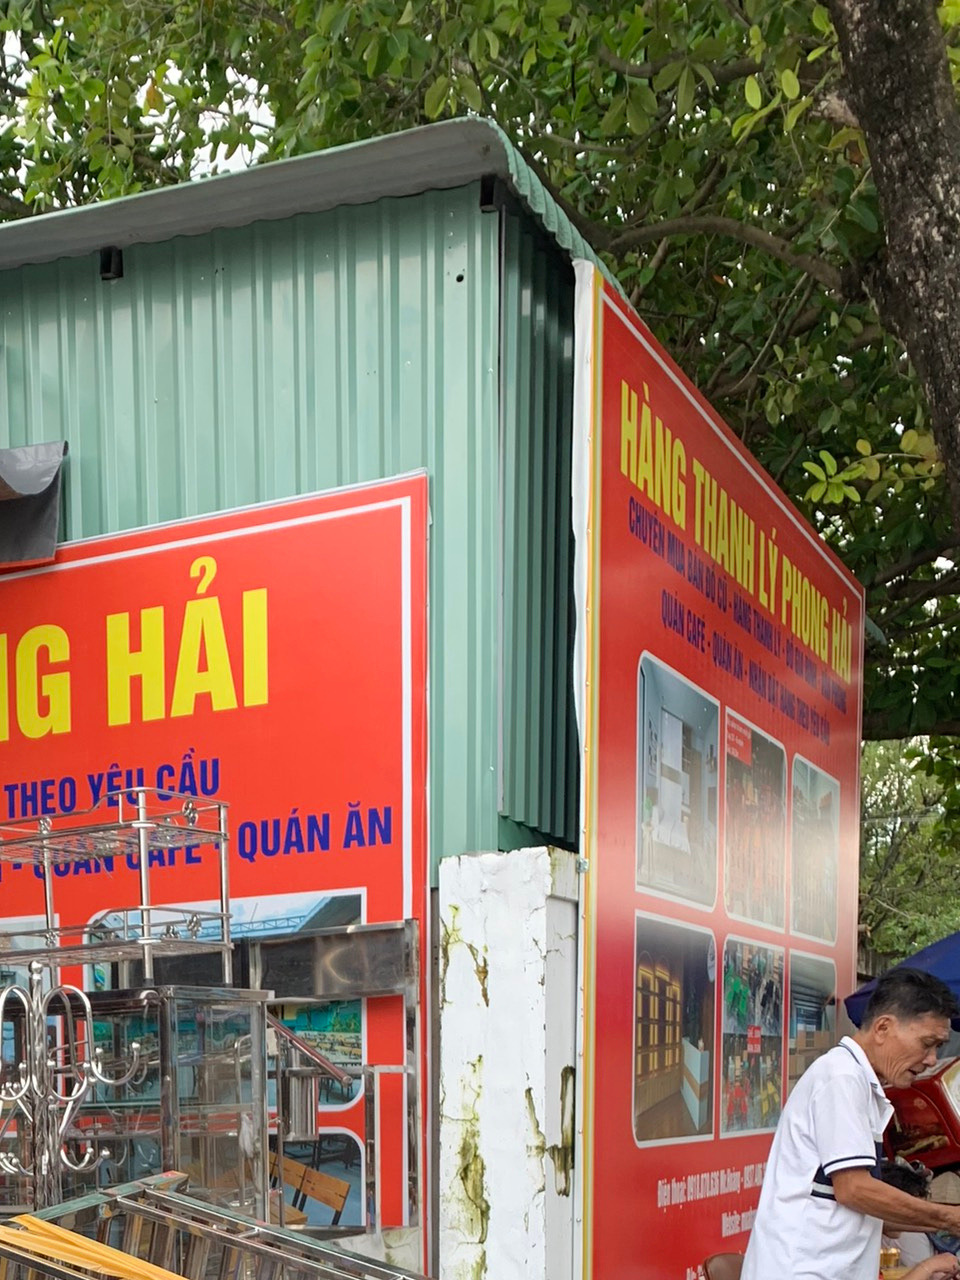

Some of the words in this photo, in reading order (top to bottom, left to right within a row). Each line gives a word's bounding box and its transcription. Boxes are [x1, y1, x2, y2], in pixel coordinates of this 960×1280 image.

[621, 379, 686, 531] HÀNG
[693, 457, 754, 596] THANH
[759, 527, 778, 616] LÝ
[782, 553, 829, 664] PHONG
[832, 596, 852, 685] HẢI
[106, 556, 269, 726] HẢI
[4, 776, 76, 818] THEO
[87, 763, 144, 809] YÊU
[156, 747, 220, 801] CẦU
[238, 808, 330, 863] QUÁN
[343, 801, 392, 849] ĂN
